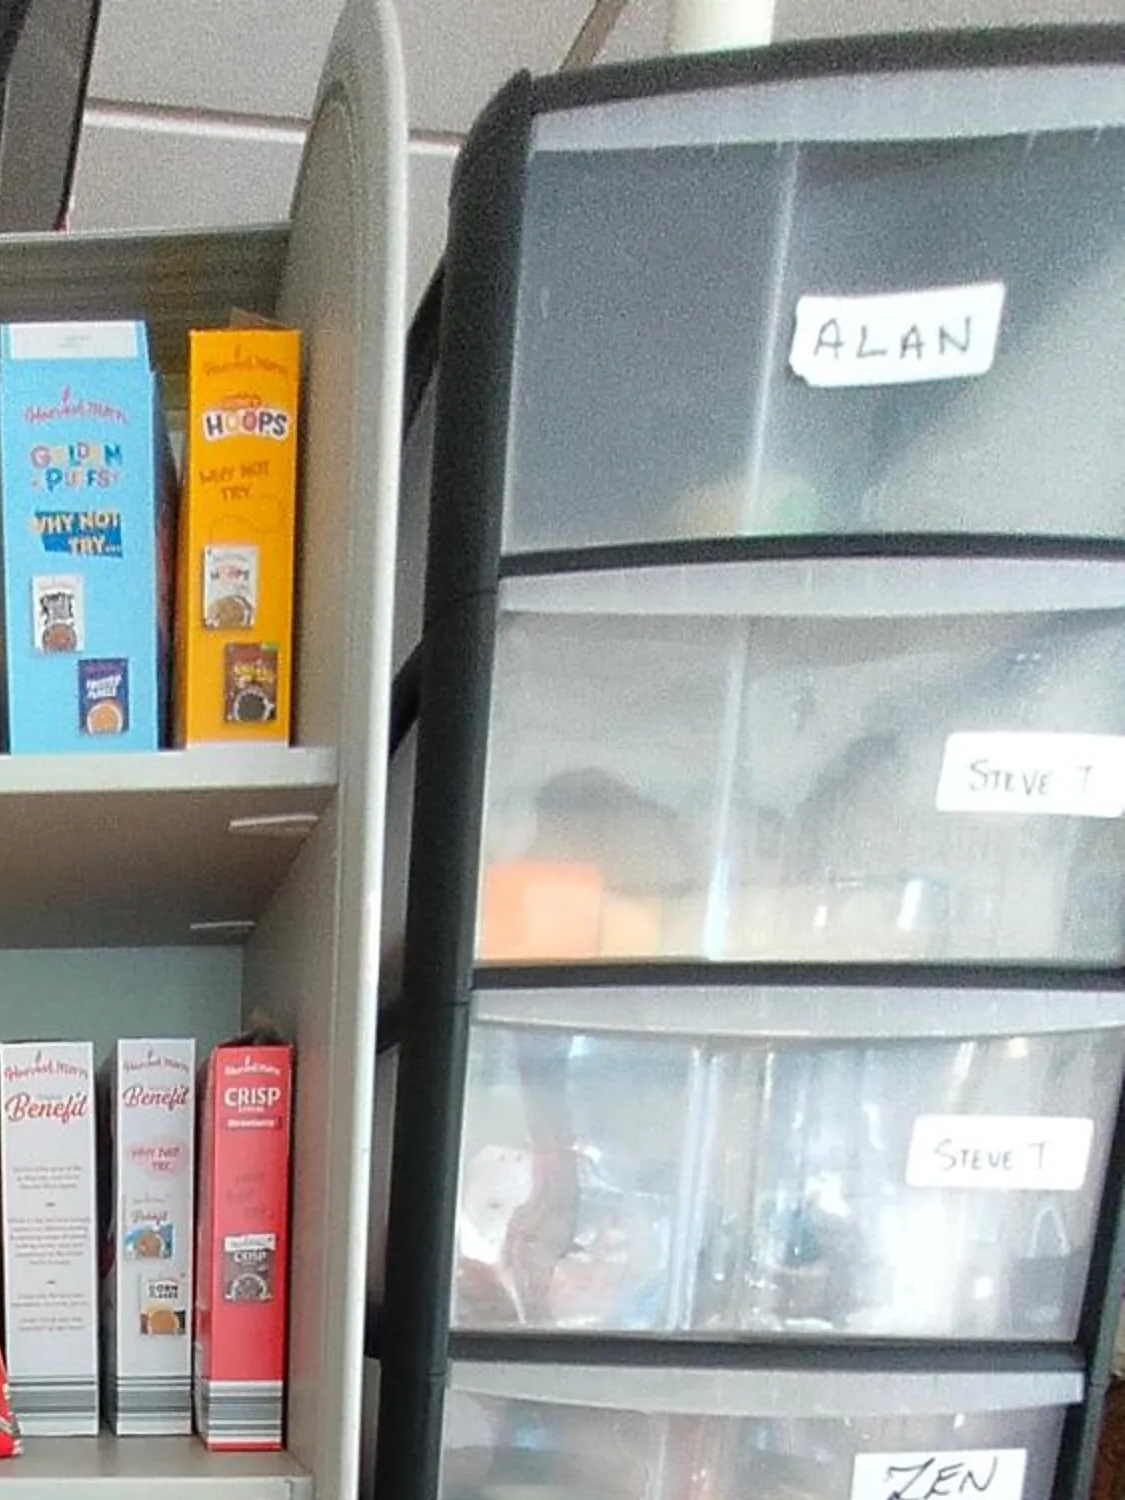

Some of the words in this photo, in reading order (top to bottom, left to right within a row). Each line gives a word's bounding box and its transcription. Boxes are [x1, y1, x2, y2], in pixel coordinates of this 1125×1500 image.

[813, 315, 972, 360] ALAN
[206, 411, 287, 436] HOOPS
[30, 442, 123, 468] GOLDEN
[5, 1092, 89, 1124] Benefit
[123, 1083, 191, 1110] Benefit
[225, 1088, 281, 1107] CRISP
